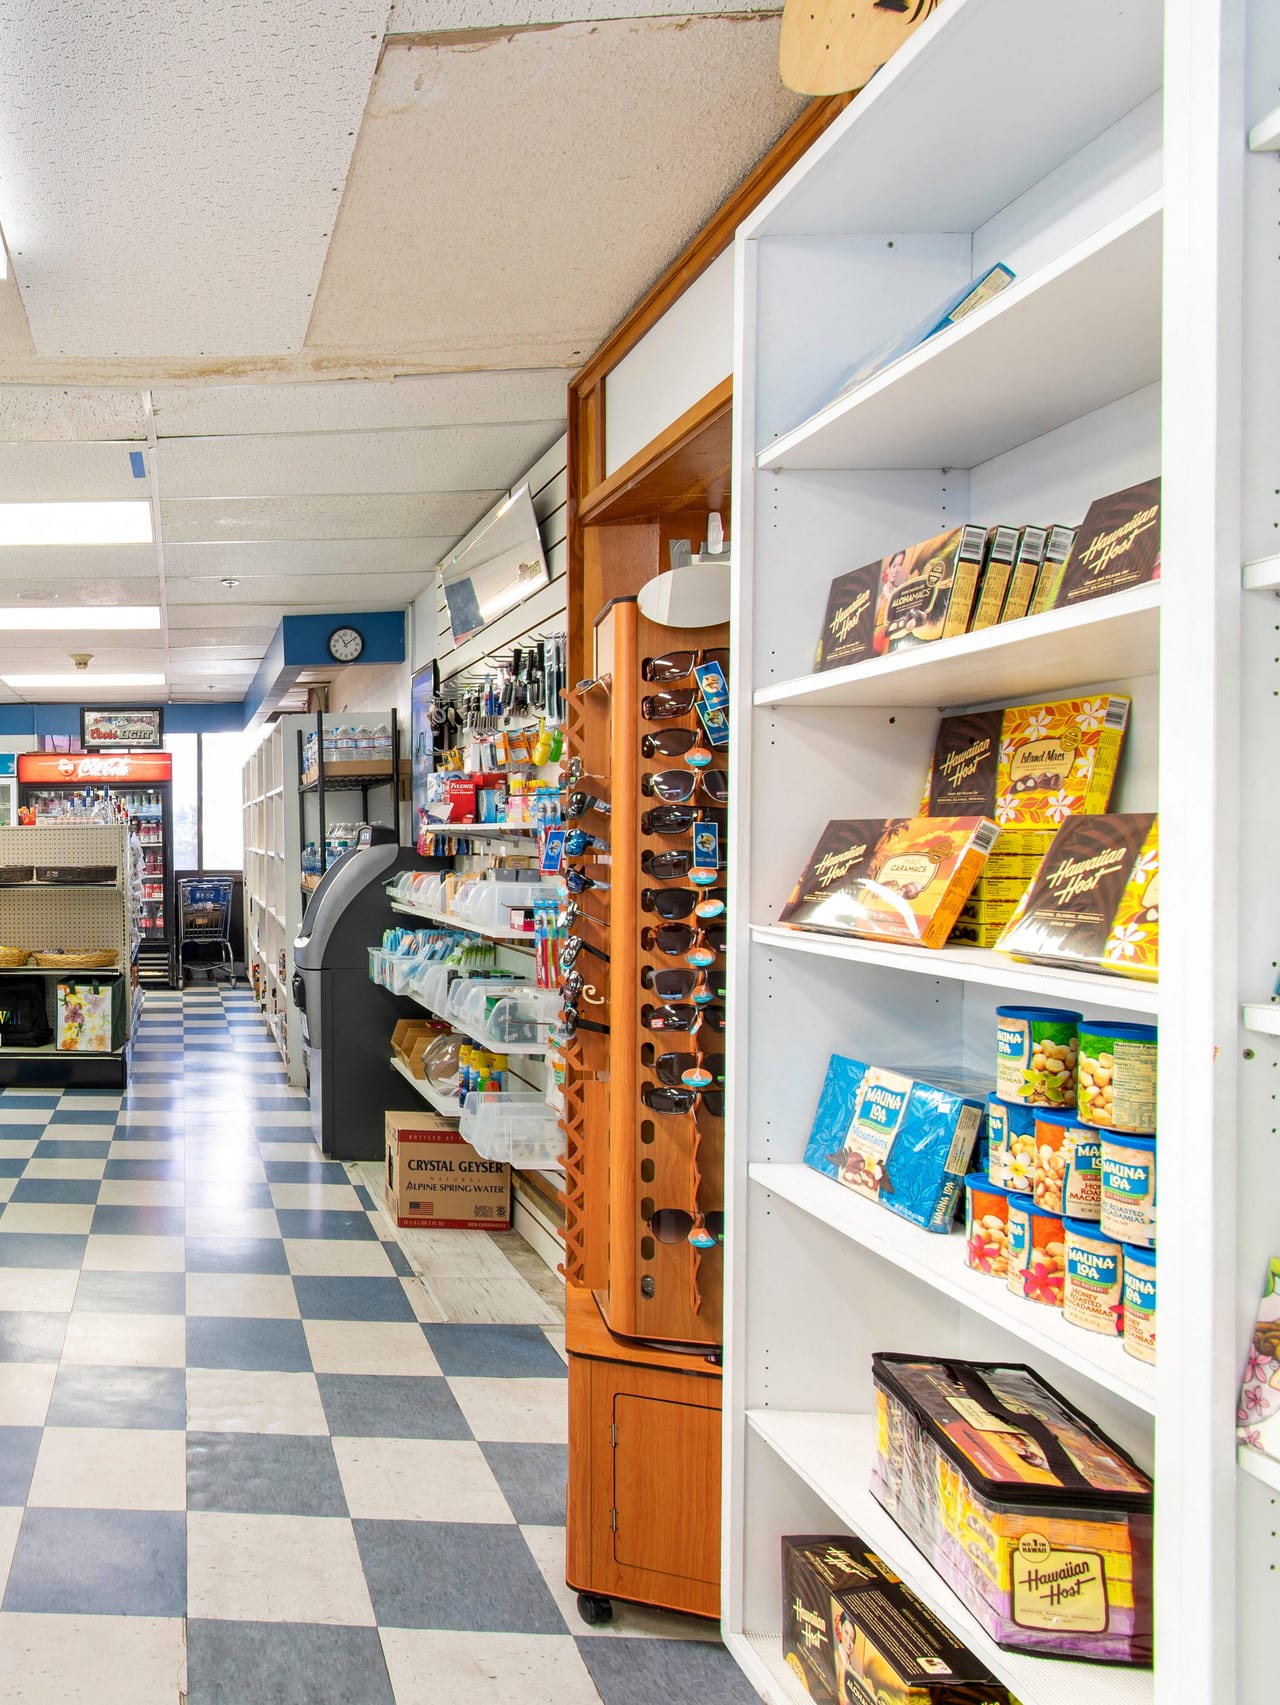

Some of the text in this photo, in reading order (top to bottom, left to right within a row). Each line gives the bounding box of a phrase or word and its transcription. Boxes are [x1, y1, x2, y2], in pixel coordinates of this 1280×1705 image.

[1078, 505, 1158, 565] Hawaiian
[1088, 520, 1156, 574] Host
[829, 589, 870, 634] Hawaiian
[836, 602, 870, 643] Host
[90, 728, 153, 741] Coors LIGHT
[940, 738, 991, 776] Hawaiian
[948, 752, 991, 788] Host
[1020, 749, 1065, 763] Island Macs
[814, 844, 867, 875] Hawaiian
[818, 858, 864, 888] Host
[890, 864, 928, 874] CARAMACS
[1046, 847, 1127, 889] Hawaiian
[1053, 864, 1123, 905] Host
[865, 1086, 902, 1110] MAUNA
[870, 1105, 887, 1123] LOA
[853, 1126, 888, 1150] Mountains
[408, 1159, 504, 1173] CRYSTAL GEYSER
[406, 1181, 505, 1193] ALPINE SPRING WATER
[1110, 1174, 1131, 1191] LOA
[933, 1181, 955, 1225] MAUNA LOA
[1068, 1249, 1115, 1269] MAUNA
[1077, 1263, 1100, 1280] LOA
[1072, 1288, 1098, 1301] HONEY
[1019, 1560, 1090, 1592] Hawaiian
[1040, 1577, 1096, 1606] Host
[792, 1597, 826, 1633] Hawaiian
[801, 1622, 828, 1649] Host
